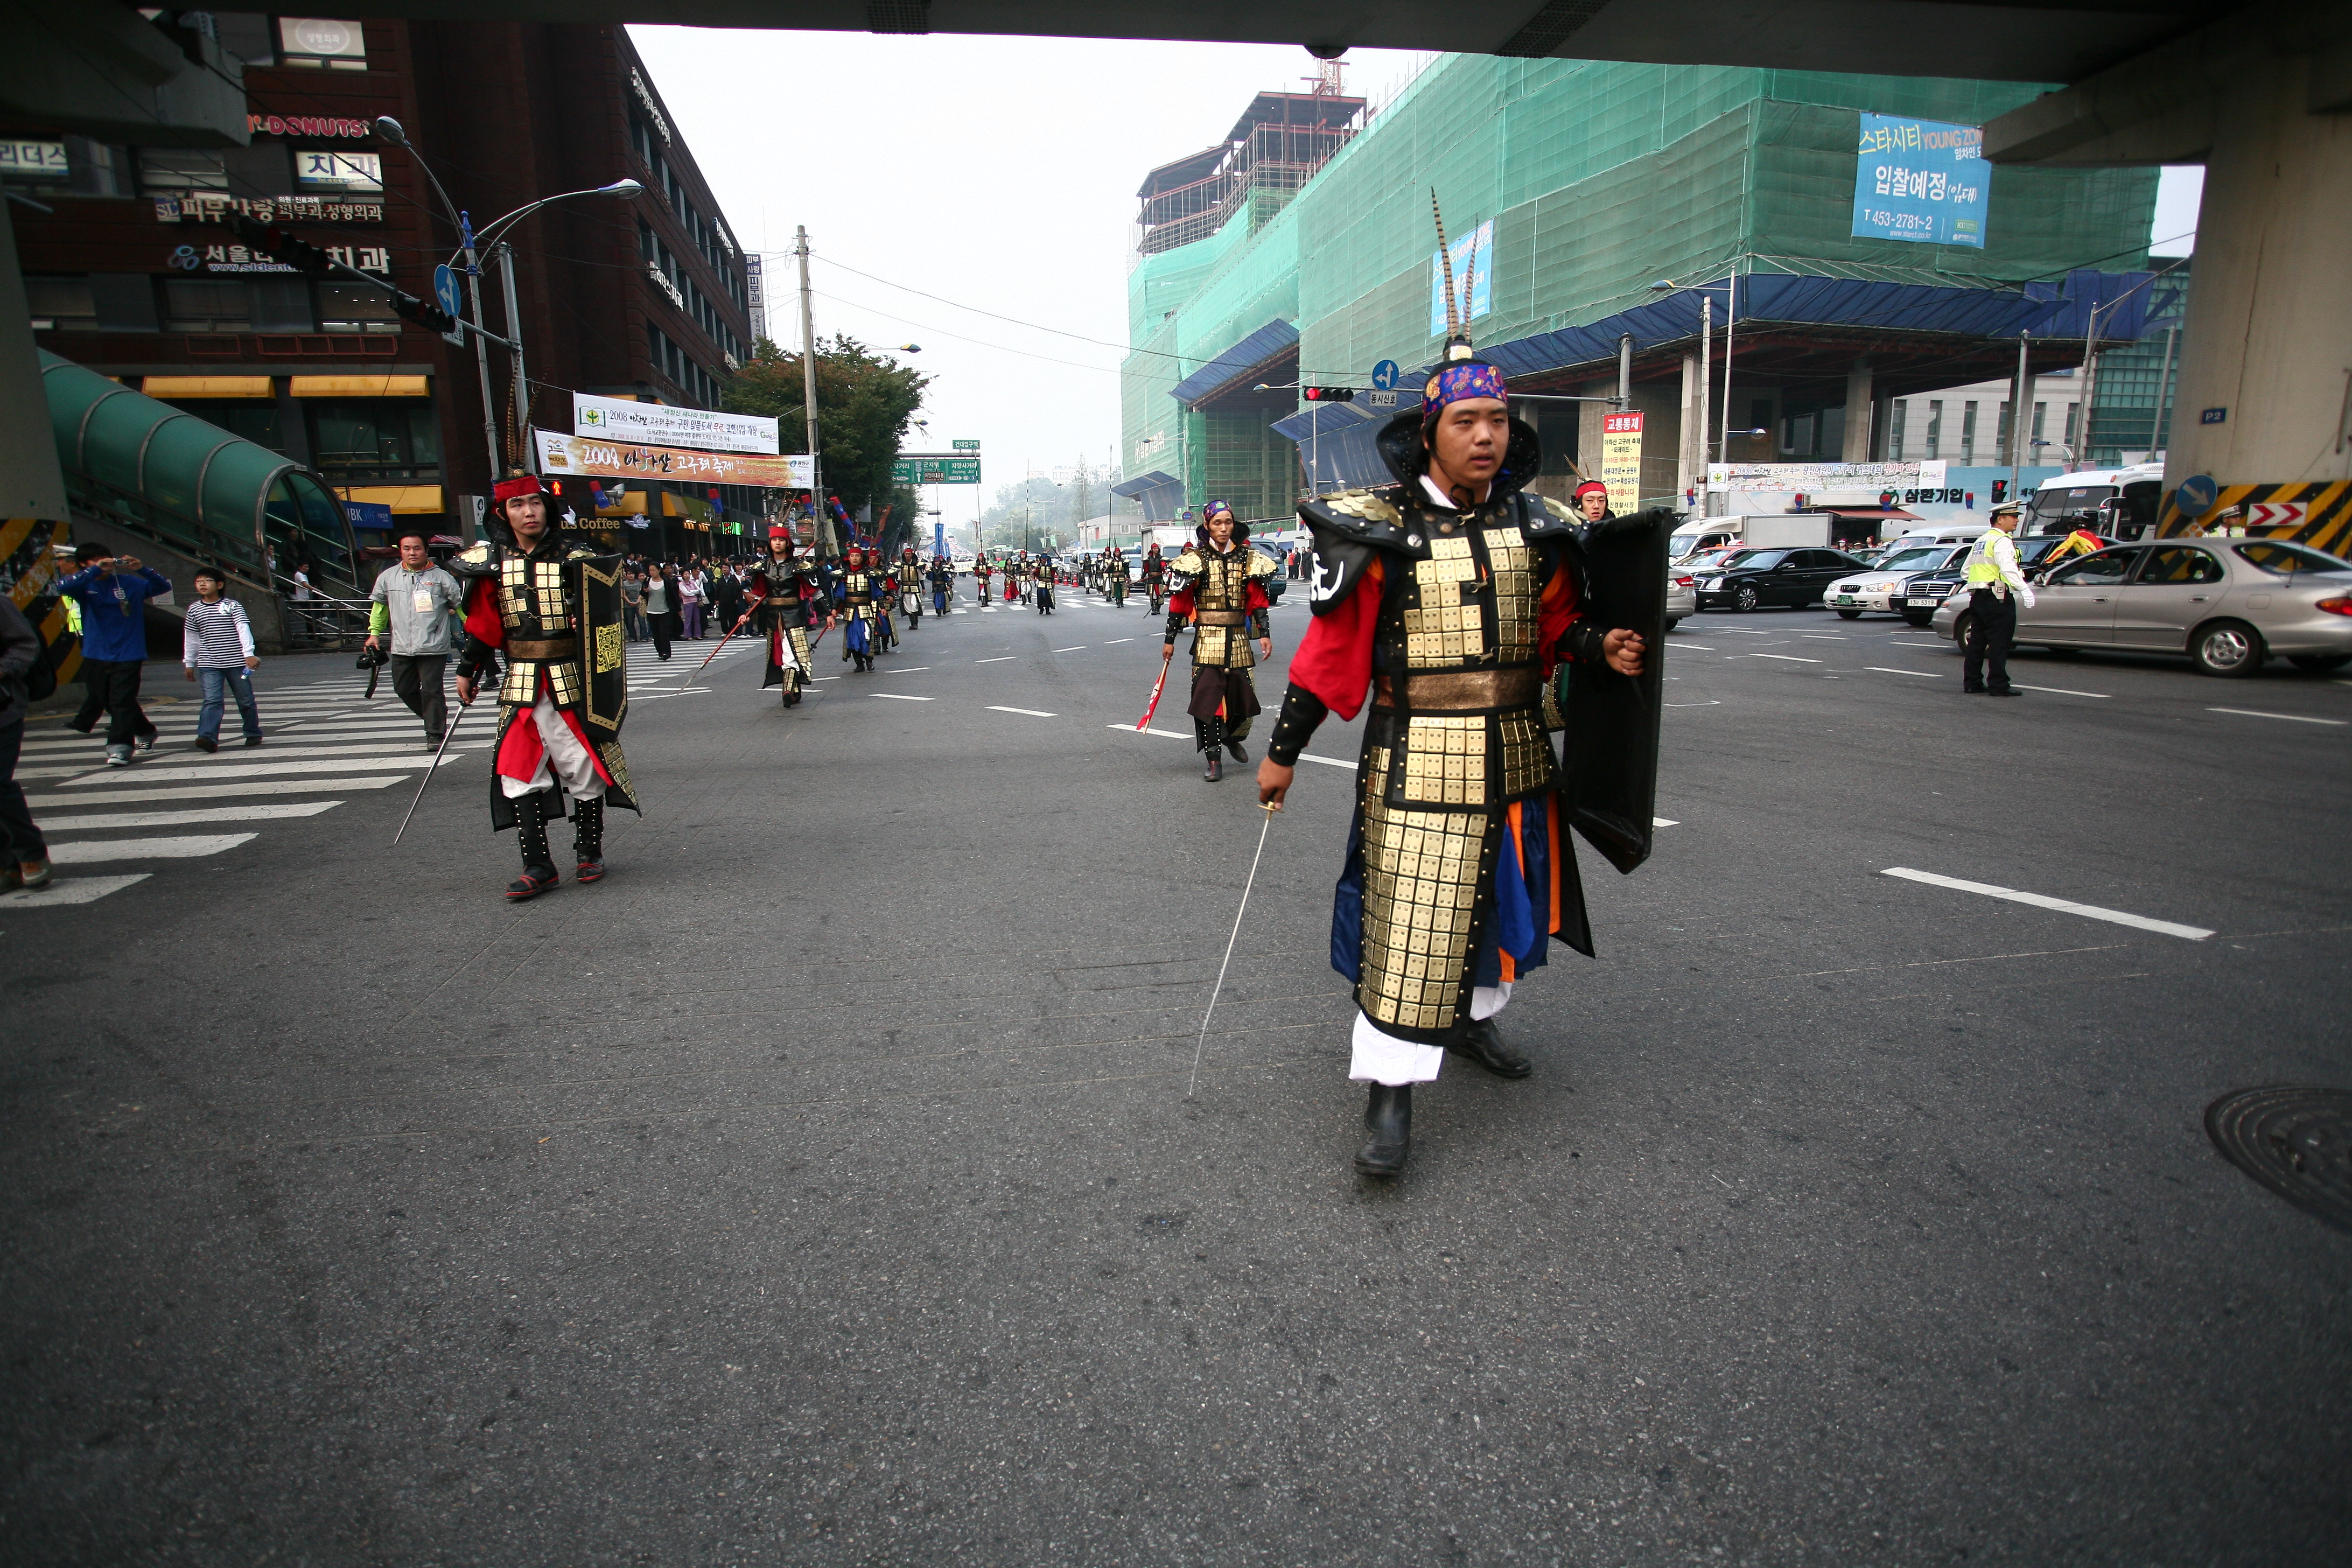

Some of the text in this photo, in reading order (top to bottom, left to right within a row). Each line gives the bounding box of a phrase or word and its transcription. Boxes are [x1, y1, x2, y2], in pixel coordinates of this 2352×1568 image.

[268, 116, 365, 137] DONUTS
[1858, 124, 1920, 155] 스타시티
[1922, 132, 1961, 150] YOUNG
[307, 155, 377, 177] 치과
[1875, 166, 1977, 204] 입찰예정 (임대)
[1864, 209, 1932, 230] T 453-2781~2
[325, 247, 390, 274] 치과
[1371, 394, 1396, 404] 동시신호
[610, 410, 628, 422] 2008
[678, 418, 689, 430] 구민
[713, 422, 725, 433] 무료
[2206, 411, 2221, 421] P2
[1607, 417, 1639, 431] 교통통제
[1618, 438, 1631, 446] 고구려
[582, 445, 620, 470] 2008
[677, 456, 710, 474] 고구려
[712, 454, 733, 478] 축제
[1736, 466, 1753, 474] 2008
[1803, 465, 1833, 475] 광진어린이
[1836, 464, 1854, 474] 고구려
[1857, 464, 1881, 474] 퀴즈대회
[1885, 464, 1903, 474] 참가자
[1906, 464, 1919, 474] 모집
[1615, 488, 1634, 496] 바랍니다
[1905, 488, 1964, 503] 삼환기업
[347, 508, 363, 521] IBK
[579, 517, 621, 529] Coffee
